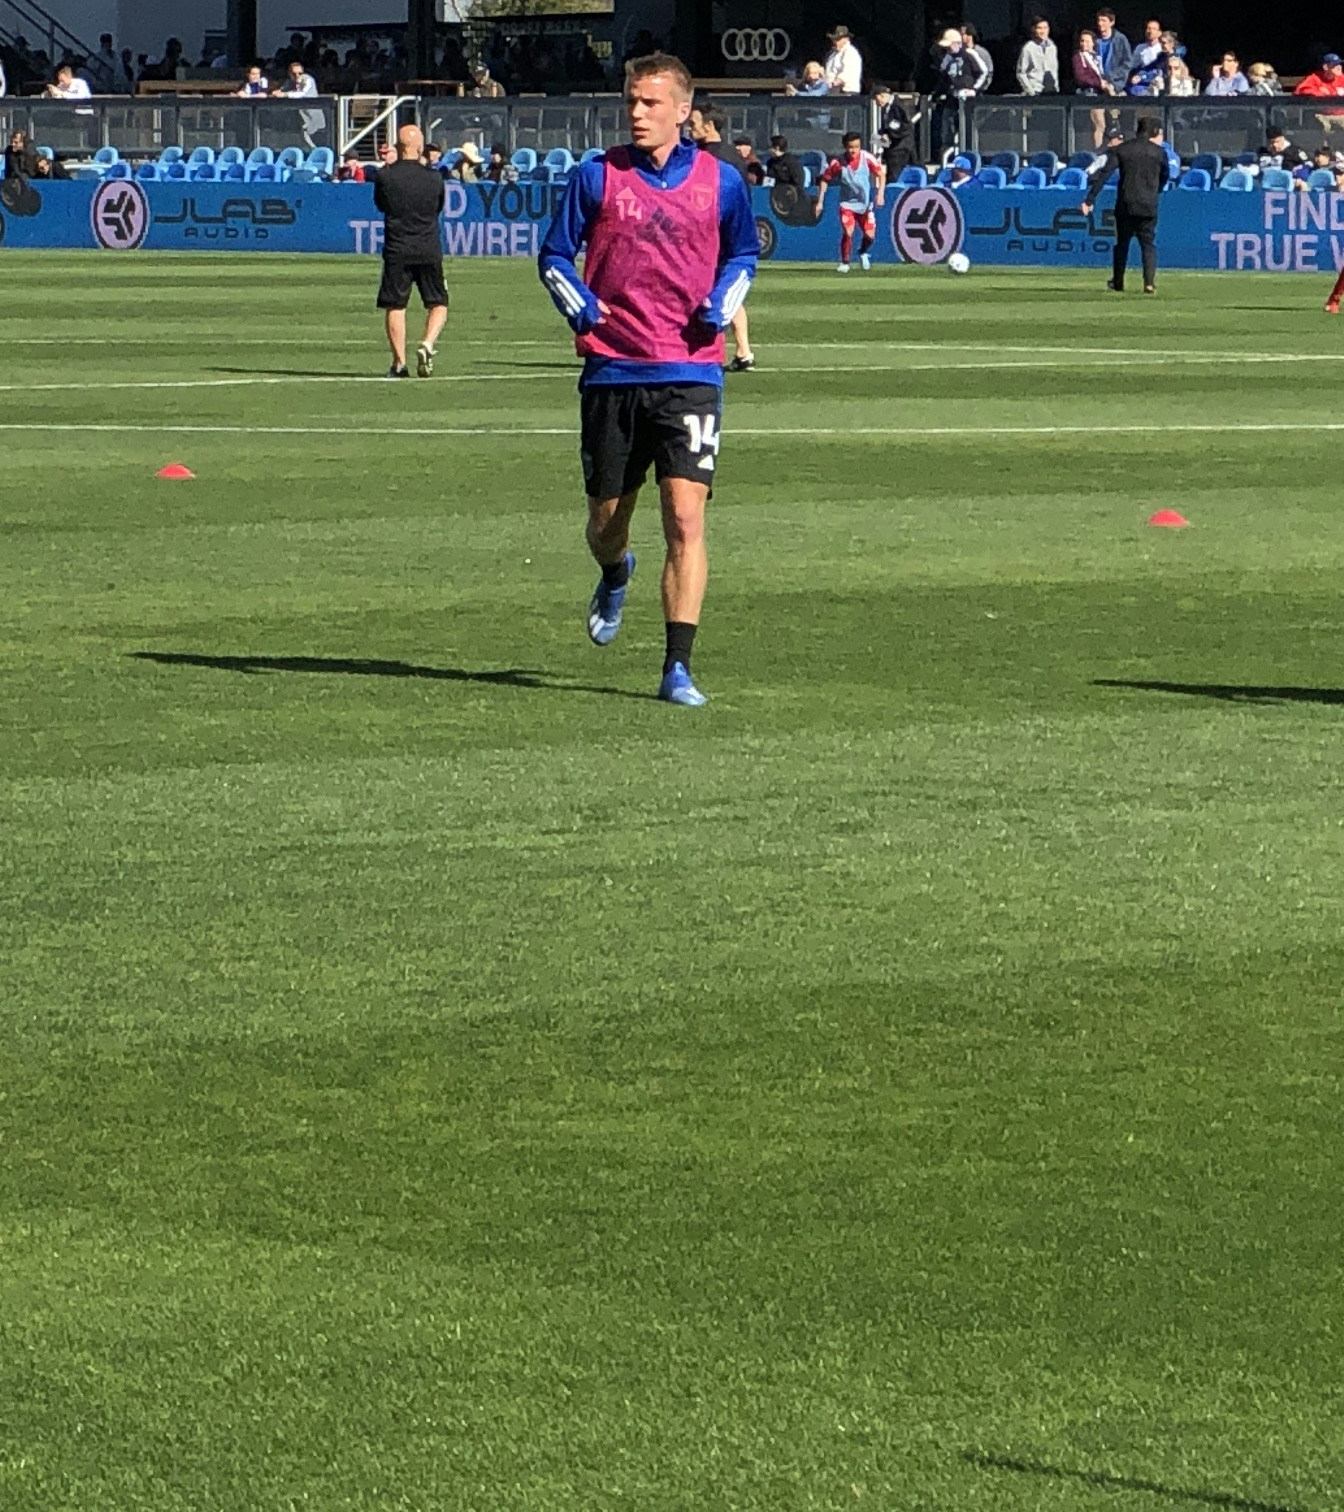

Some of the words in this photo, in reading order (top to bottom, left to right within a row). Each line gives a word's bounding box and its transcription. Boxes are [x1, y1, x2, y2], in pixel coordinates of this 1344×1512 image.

[615, 199, 642, 222] 14
[184, 227, 269, 239] AUDIO
[443, 221, 539, 257] WIREL
[1007, 239, 1111, 253] AUDIO
[1210, 232, 1319, 272] TRUE
[683, 414, 720, 455] 14
